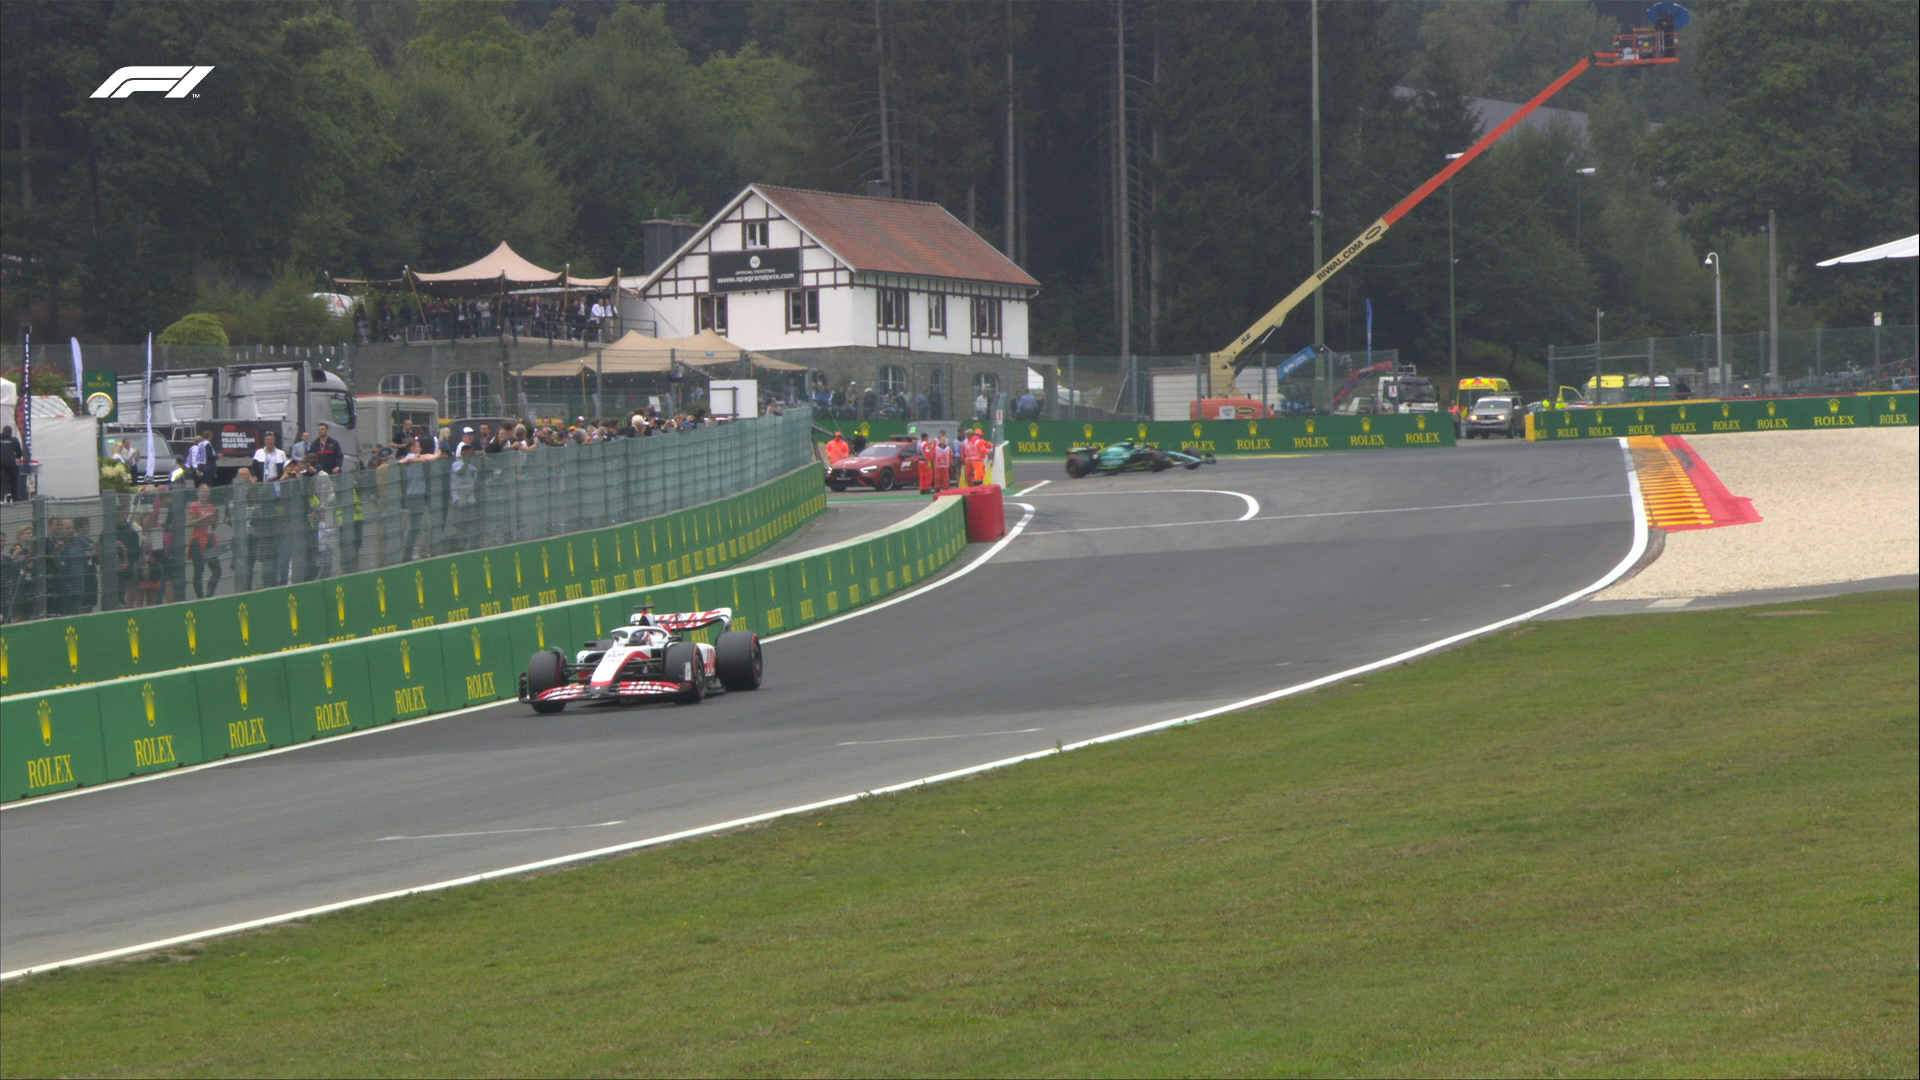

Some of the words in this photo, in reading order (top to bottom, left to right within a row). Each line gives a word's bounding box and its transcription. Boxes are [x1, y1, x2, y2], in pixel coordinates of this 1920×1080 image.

[1316, 240, 1364, 281] RIWAL.COM
[717, 273, 794, 284] www.spagrandprix.com
[1757, 418, 1788, 429] ROLEX
[1814, 415, 1856, 426] ROLEX
[1880, 414, 1908, 424] ROLEX
[1628, 424, 1655, 435] ROLEX
[1671, 422, 1696, 433] ROLEX
[1713, 420, 1740, 430] ROLEX
[1589, 426, 1613, 436] ROLEX
[1293, 437, 1329, 448] ROLEX
[1350, 434, 1385, 446] ROLEX
[1406, 432, 1440, 444] ROLEX
[1018, 441, 1052, 452] ROLEX
[1181, 440, 1216, 451] ROLEX
[1237, 439, 1272, 450] ROLEX
[465, 672, 496, 700] ROLEX
[394, 685, 428, 715] ROLEX
[315, 701, 350, 731] ROLEX
[228, 717, 268, 749] ROLEX
[134, 735, 176, 767] ROLEX
[27, 754, 74, 789] ROLEX
